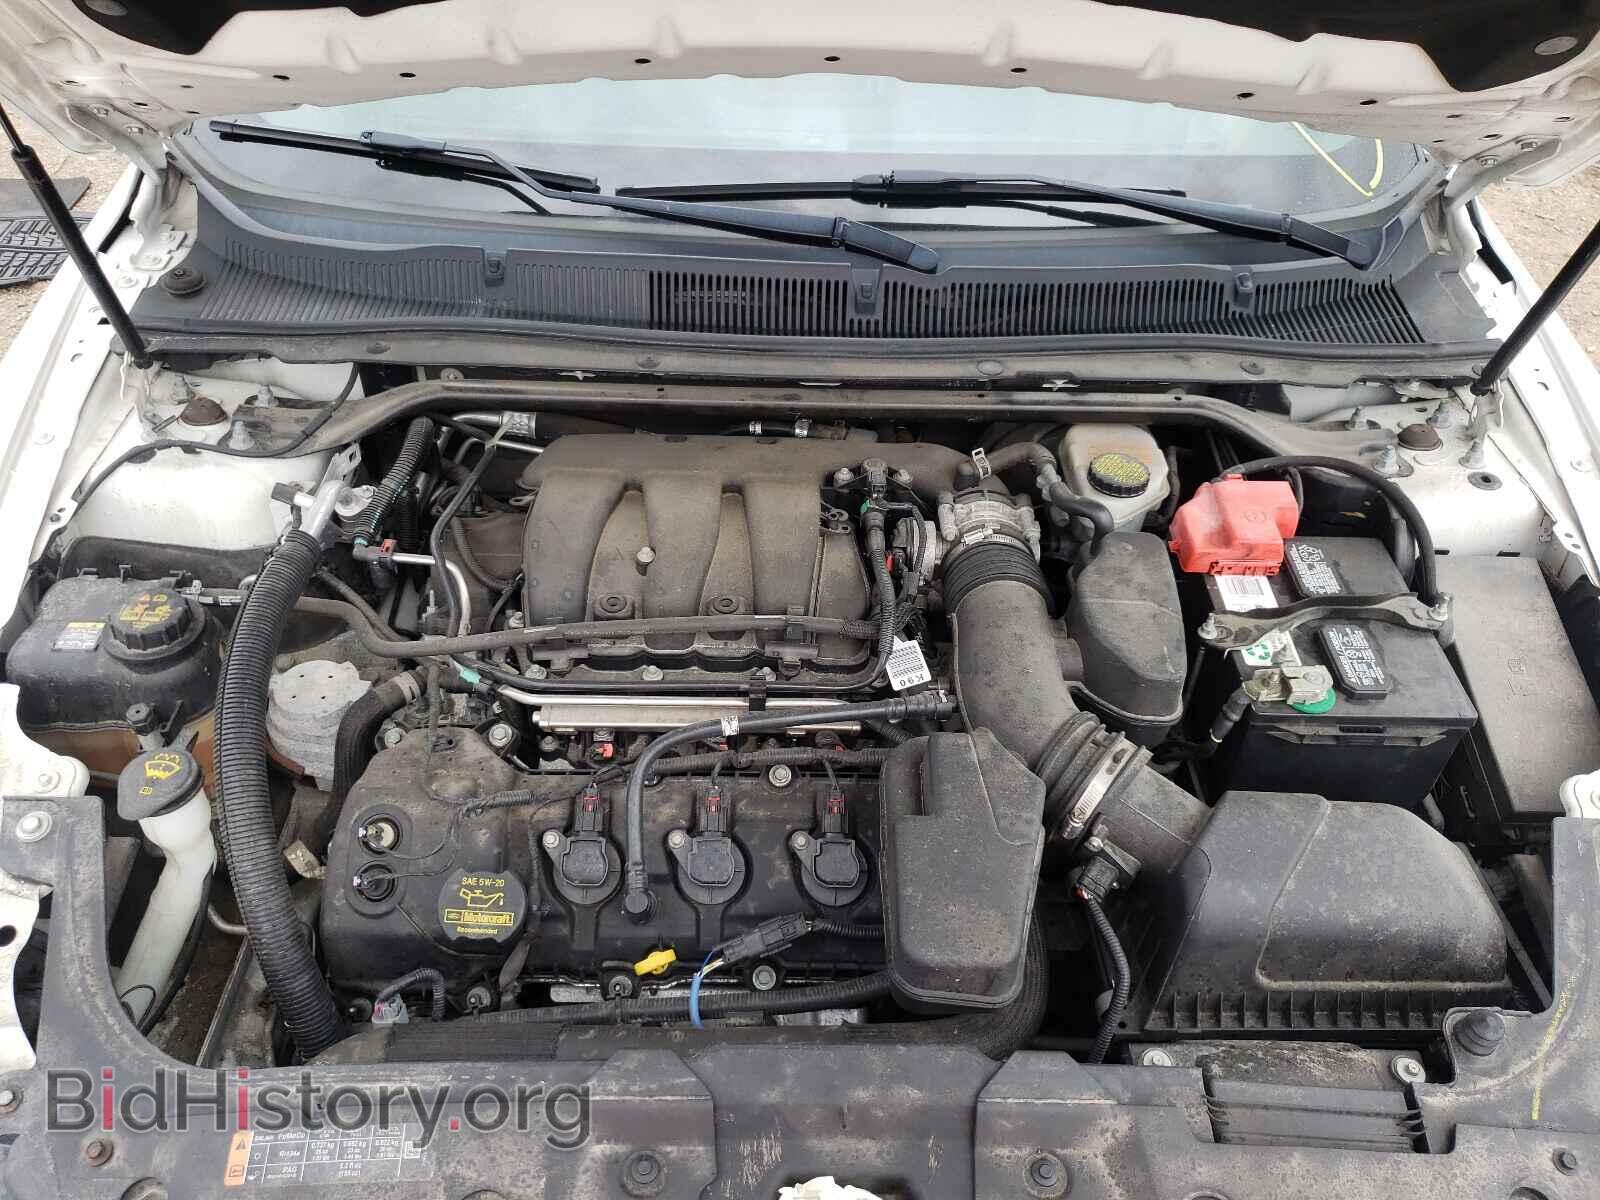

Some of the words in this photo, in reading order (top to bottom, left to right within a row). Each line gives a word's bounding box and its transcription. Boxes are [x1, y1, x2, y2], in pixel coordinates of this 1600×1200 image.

[462, 877, 478, 886] SAE
[479, 878, 505, 887] 5W-20
[463, 911, 512, 925] Motorcraft
[457, 926, 498, 935] Recommended
